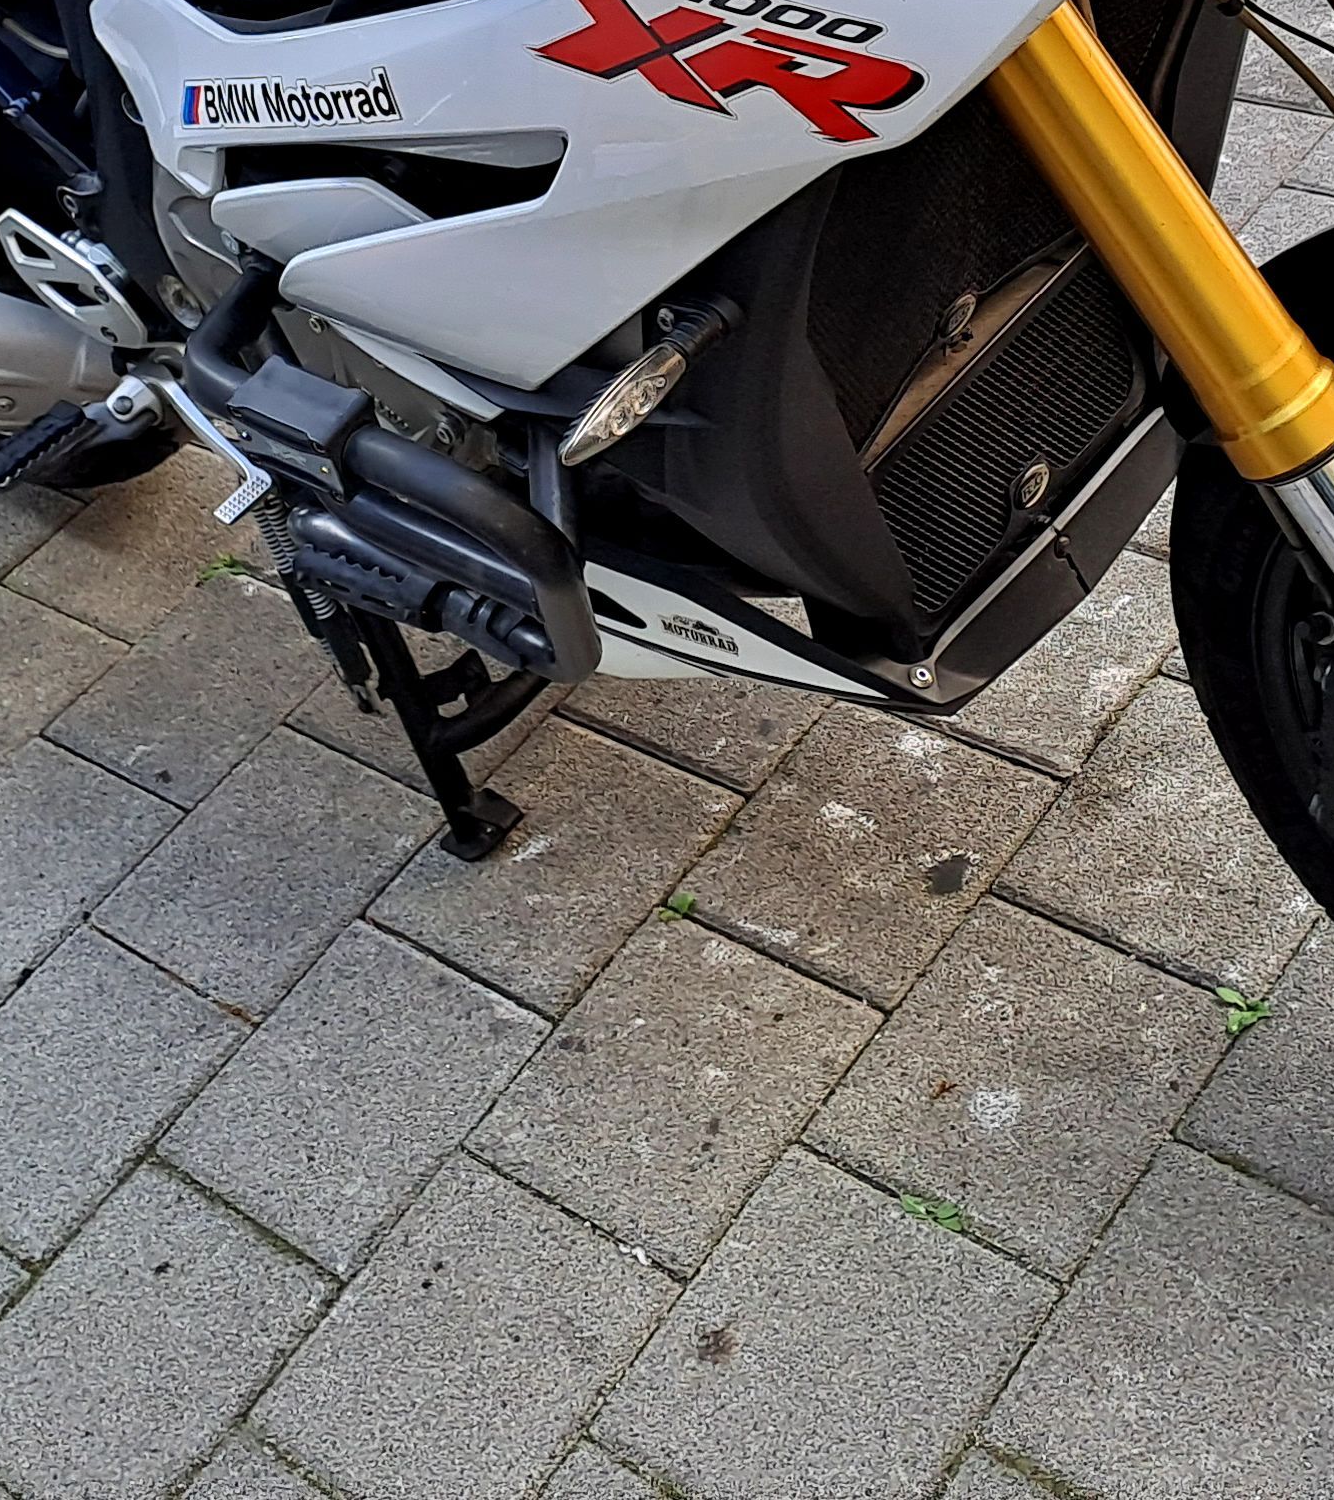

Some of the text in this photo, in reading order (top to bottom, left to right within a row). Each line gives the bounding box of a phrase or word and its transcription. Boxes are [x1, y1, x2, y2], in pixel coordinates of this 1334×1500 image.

[204, 73, 397, 124] BMW Motorrad
[661, 619, 739, 653] MOTORRAD
